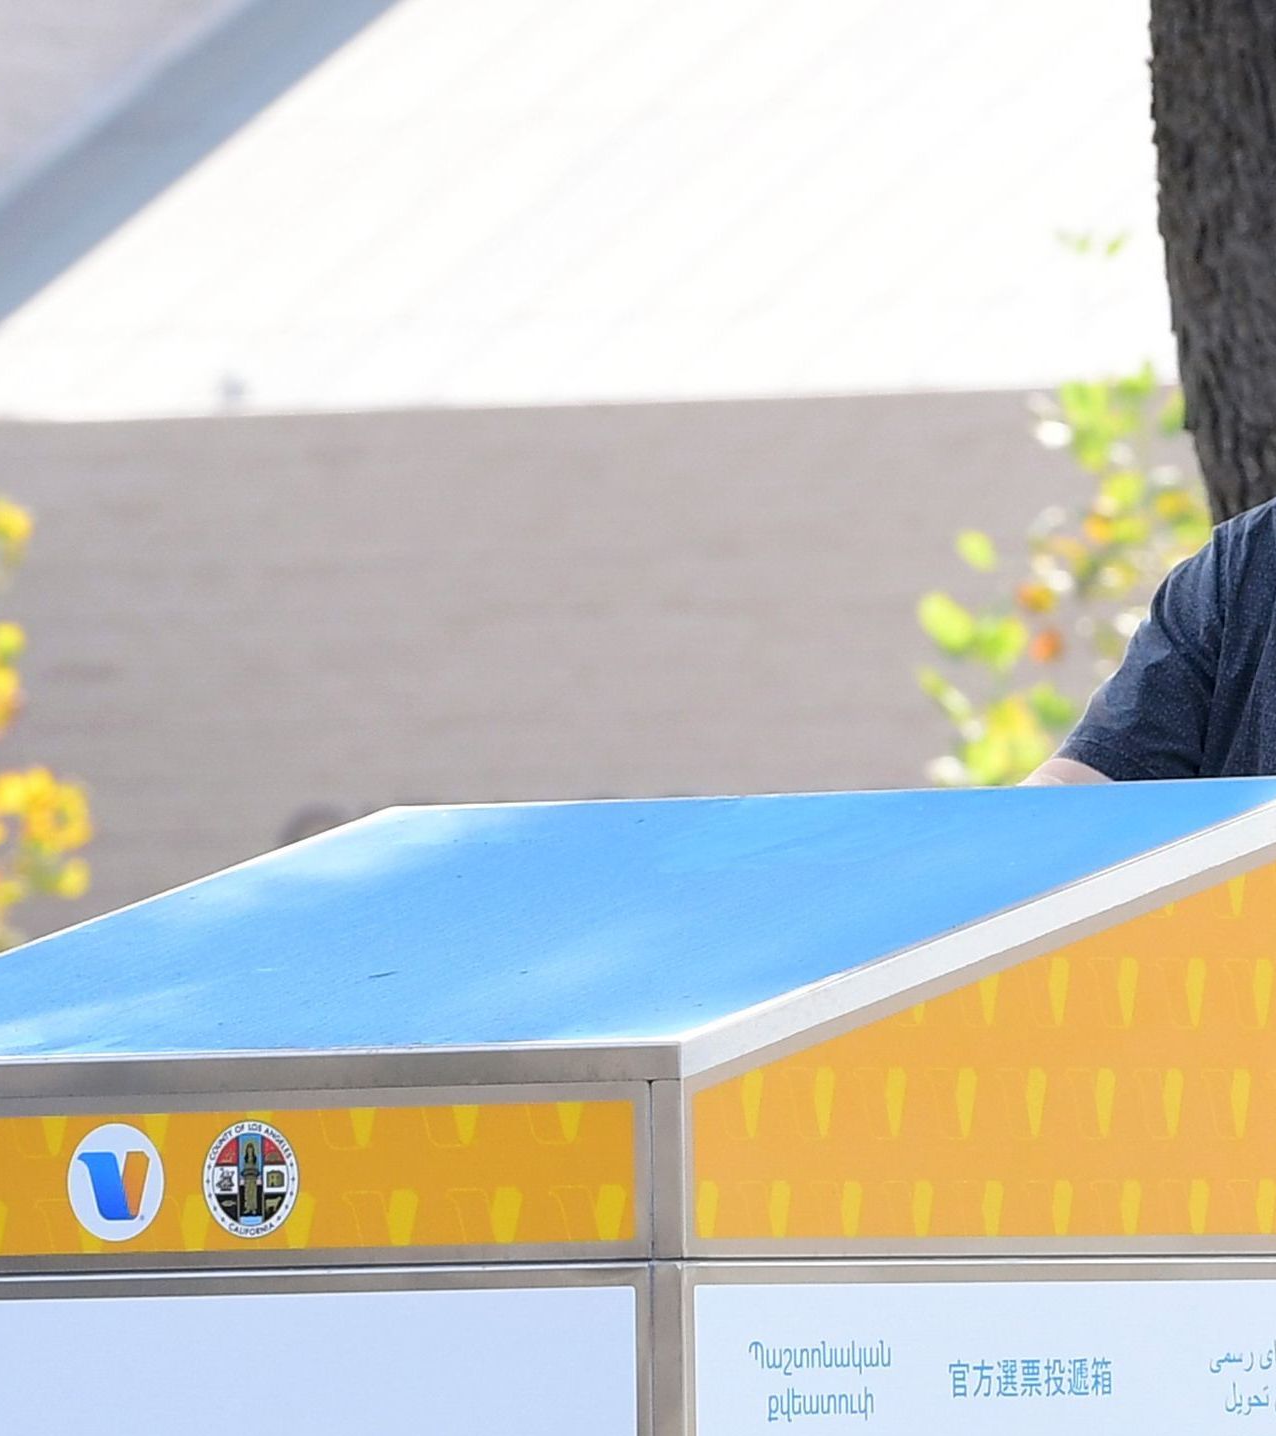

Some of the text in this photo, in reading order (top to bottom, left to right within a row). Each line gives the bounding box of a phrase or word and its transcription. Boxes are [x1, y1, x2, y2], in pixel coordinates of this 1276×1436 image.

[234, 1125, 245, 1134] OF
[248, 1123, 262, 1132] LOS
[228, 1222, 275, 1236] CALIFORNIA
[749, 1339, 892, 1375] Պաշտոնական
[1209, 1350, 1254, 1373] رسمی
[948, 1356, 1113, 1399] 官方選票投遞箱
[767, 1386, 875, 1422] քվեատուփ
[1224, 1381, 1270, 1415] تحویل
